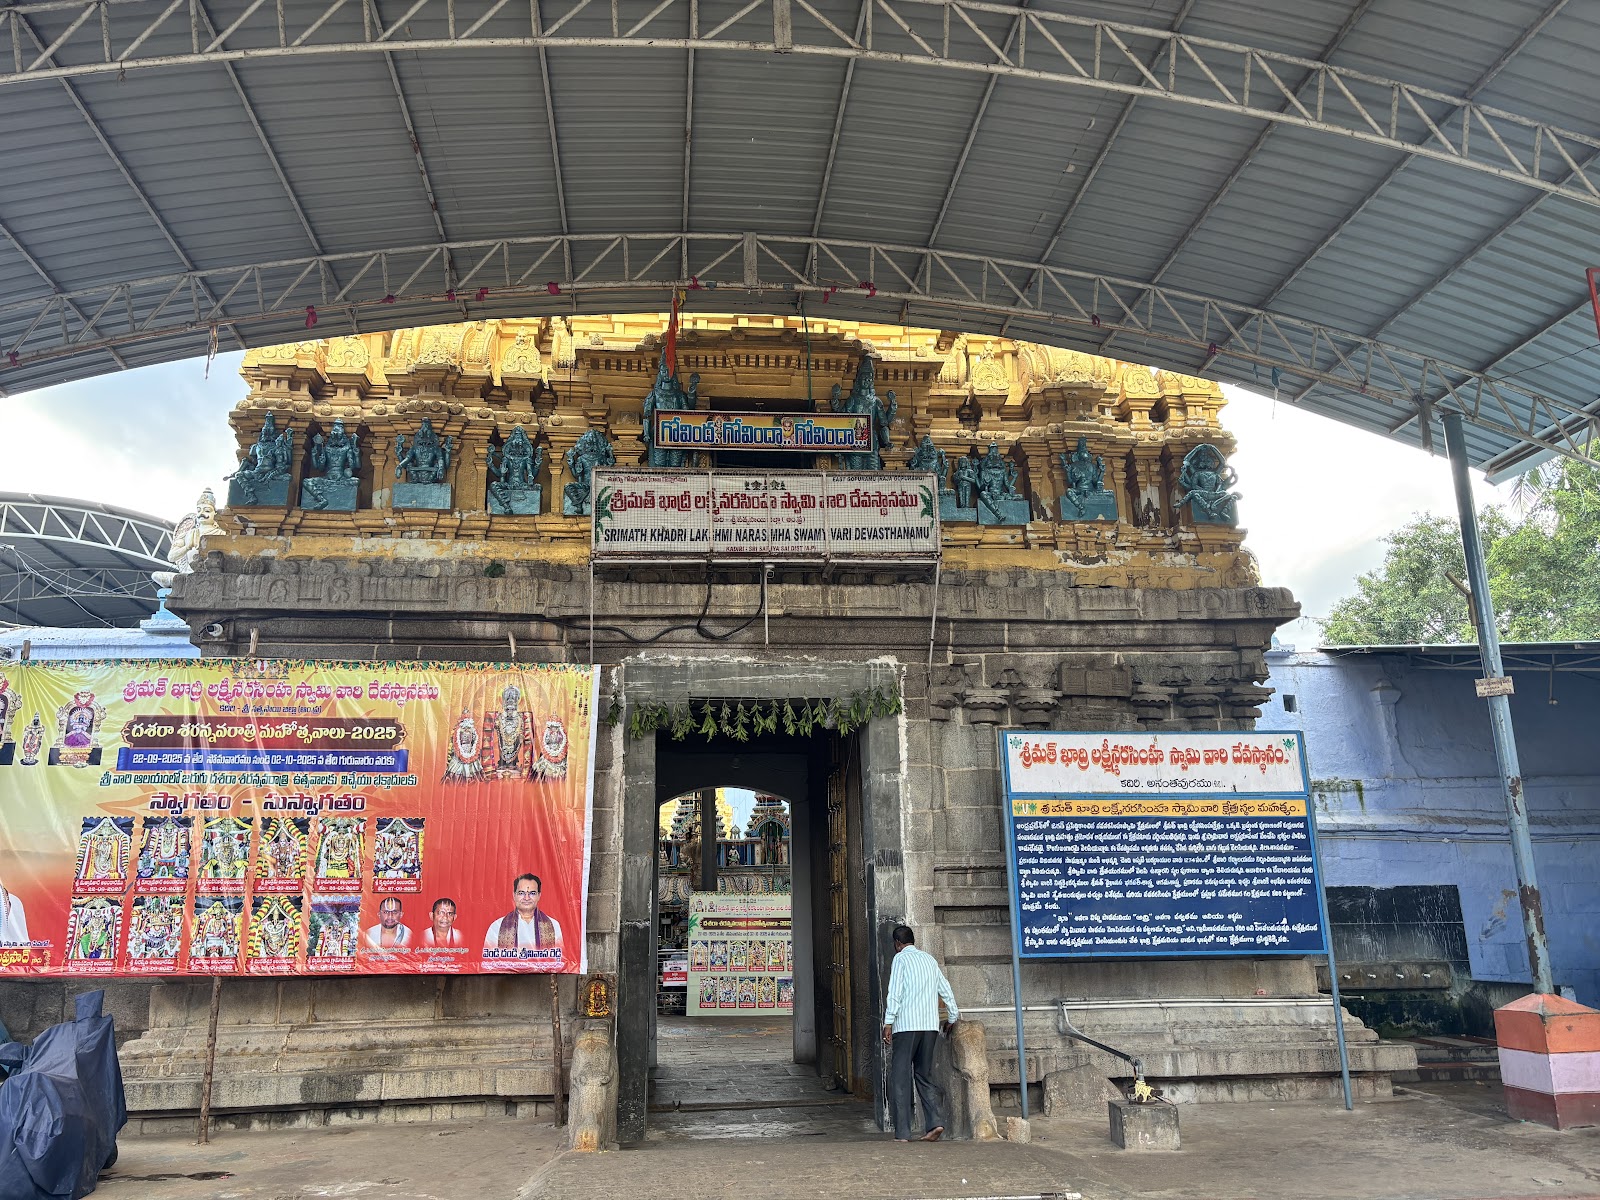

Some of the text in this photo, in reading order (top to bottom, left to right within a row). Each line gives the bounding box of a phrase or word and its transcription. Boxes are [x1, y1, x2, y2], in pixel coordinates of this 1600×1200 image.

[610, 489, 656, 512] శ్రీమత్
[781, 492, 816, 514] స్వామి
[850, 489, 918, 517] దేవస్థానము
[604, 528, 647, 542] SRIMATH
[650, 528, 687, 542] KHADRI
[690, 528, 732, 542] LAKHMI
[735, 528, 791, 542] NARASMHA
[830, 527, 852, 541] VARI
[855, 526, 930, 541] DEVASTHANAMU
[123, 677, 169, 702] శ్రీమత్
[295, 681, 332, 704] స్వామి
[335, 685, 363, 700] వారి
[367, 679, 439, 706] దేవస్థానము
[131, 720, 397, 744] దశరా శరన్నవరాత్రి మహోత్సవాలు-2025
[132, 753, 183, 764] 22-09-2025
[206, 754, 252, 765] సోమవారము
[271, 754, 316, 765] 02-10-2025
[338, 755, 375, 766] గురువారం
[375, 756, 395, 766] వరకు
[1019, 741, 1058, 769] శ్రీమత్
[1169, 745, 1201, 771] స్వామి
[1203, 747, 1229, 766] వారి
[100, 771, 112, 786] శ్రీ
[112, 774, 133, 784] వారి
[134, 770, 182, 785] ఆలయంలో
[182, 773, 208, 784] జరుగు
[209, 773, 236, 785] దశరా
[238, 773, 289, 787] శరన్నవరాత్రి
[293, 774, 338, 789] ఉత్సవాలకు
[340, 771, 372, 788] విచ్చేయు
[1146, 778, 1212, 790] అనంతపురము
[149, 791, 232, 815] స్వాగతం
[263, 792, 366, 816] సుస్వాగతం
[519, 947, 549, 960] శ్రీనివాస
[549, 948, 562, 962] రెడ్డి
